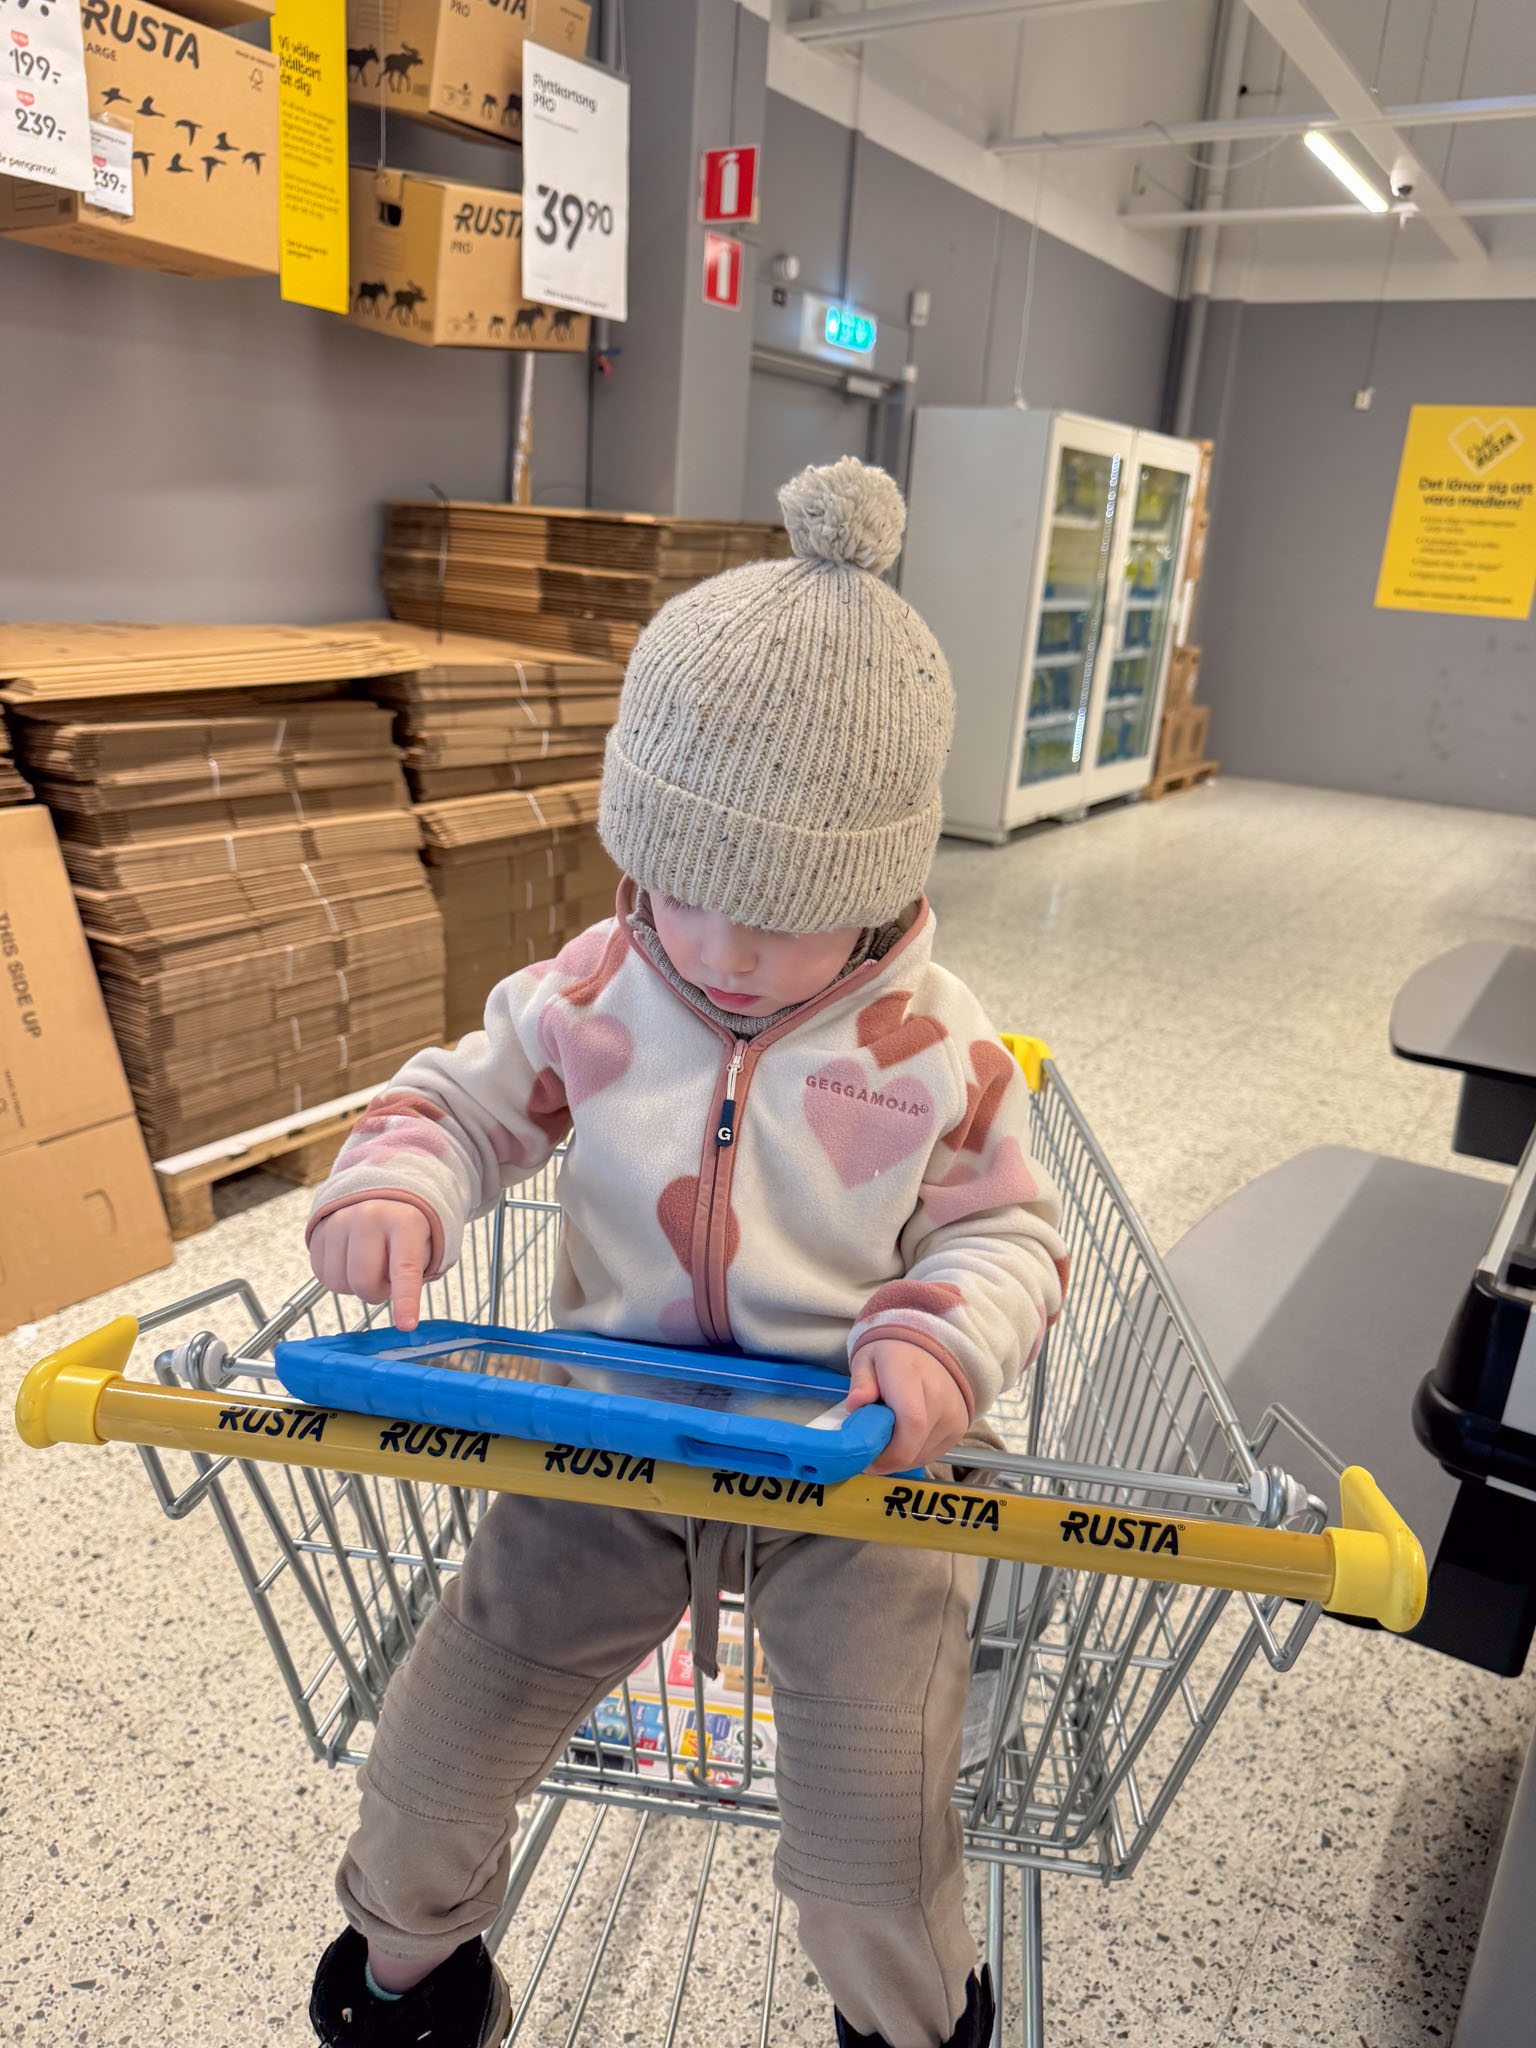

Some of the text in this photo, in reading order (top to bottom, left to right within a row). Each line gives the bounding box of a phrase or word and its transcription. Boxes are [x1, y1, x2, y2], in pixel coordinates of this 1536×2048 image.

[82, 0, 200, 69] RUSTA
[85, 42, 117, 62] ARGE
[533, 93, 556, 112] PRO
[8, 961, 34, 1007] SIDE
[21, 1010, 42, 1038] UP
[717, 1127, 731, 1141] G
[380, 1421, 491, 1463] RUSTA
[544, 1442, 656, 1484] RUSTA
[883, 1486, 999, 1531] RUSTA
[1060, 1511, 1179, 1556] RUSTA
